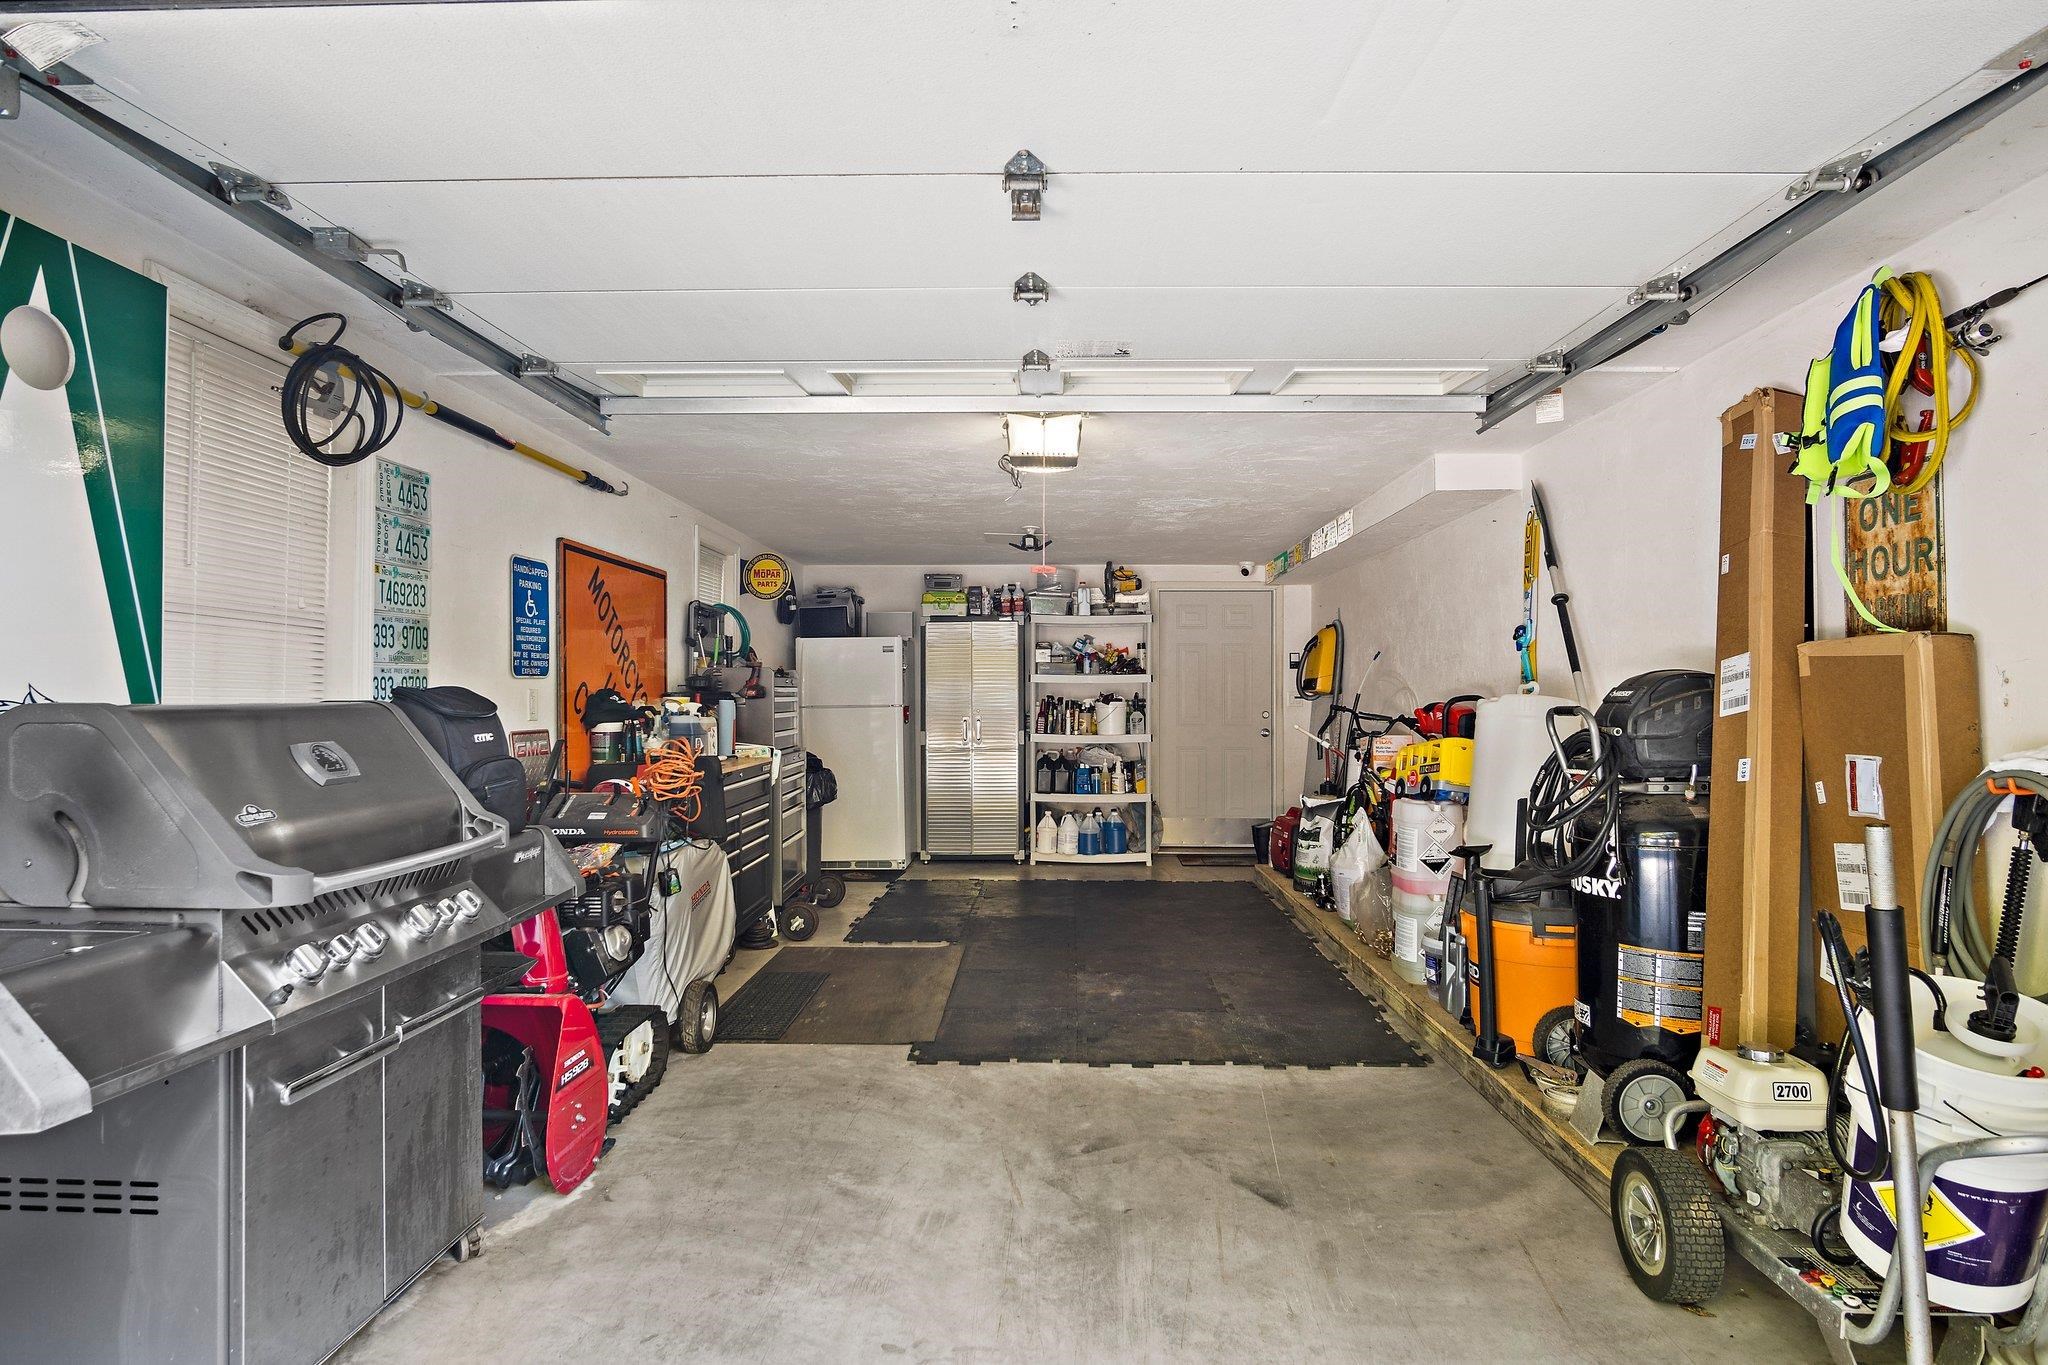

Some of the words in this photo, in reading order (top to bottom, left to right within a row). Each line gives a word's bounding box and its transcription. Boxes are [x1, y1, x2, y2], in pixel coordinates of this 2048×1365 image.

[398, 480, 428, 512] 4453
[1859, 492, 1922, 532] ONE
[395, 530, 428, 561] 4453
[1850, 535, 1935, 583] HOUR
[513, 564, 547, 578] HANDICAPPED
[518, 579, 542, 590] PARKING
[379, 579, 427, 608] T469283
[515, 616, 532, 625] SPECIAL
[533, 618, 546, 626] PLATE
[373, 623, 395, 648] 393
[401, 625, 429, 650] 9709
[520, 626, 542, 634] REQUIRED
[515, 635, 547, 643] UNAUTHORIZED
[530, 652, 549, 660] REMOVED
[521, 667, 541, 675] EXPENSE
[372, 675, 394, 701] 393
[514, 740, 550, 758] GMC
[551, 828, 586, 836] ONDA
[603, 829, 640, 837] Hydrostatic
[1776, 1085, 1808, 1099] 2700
